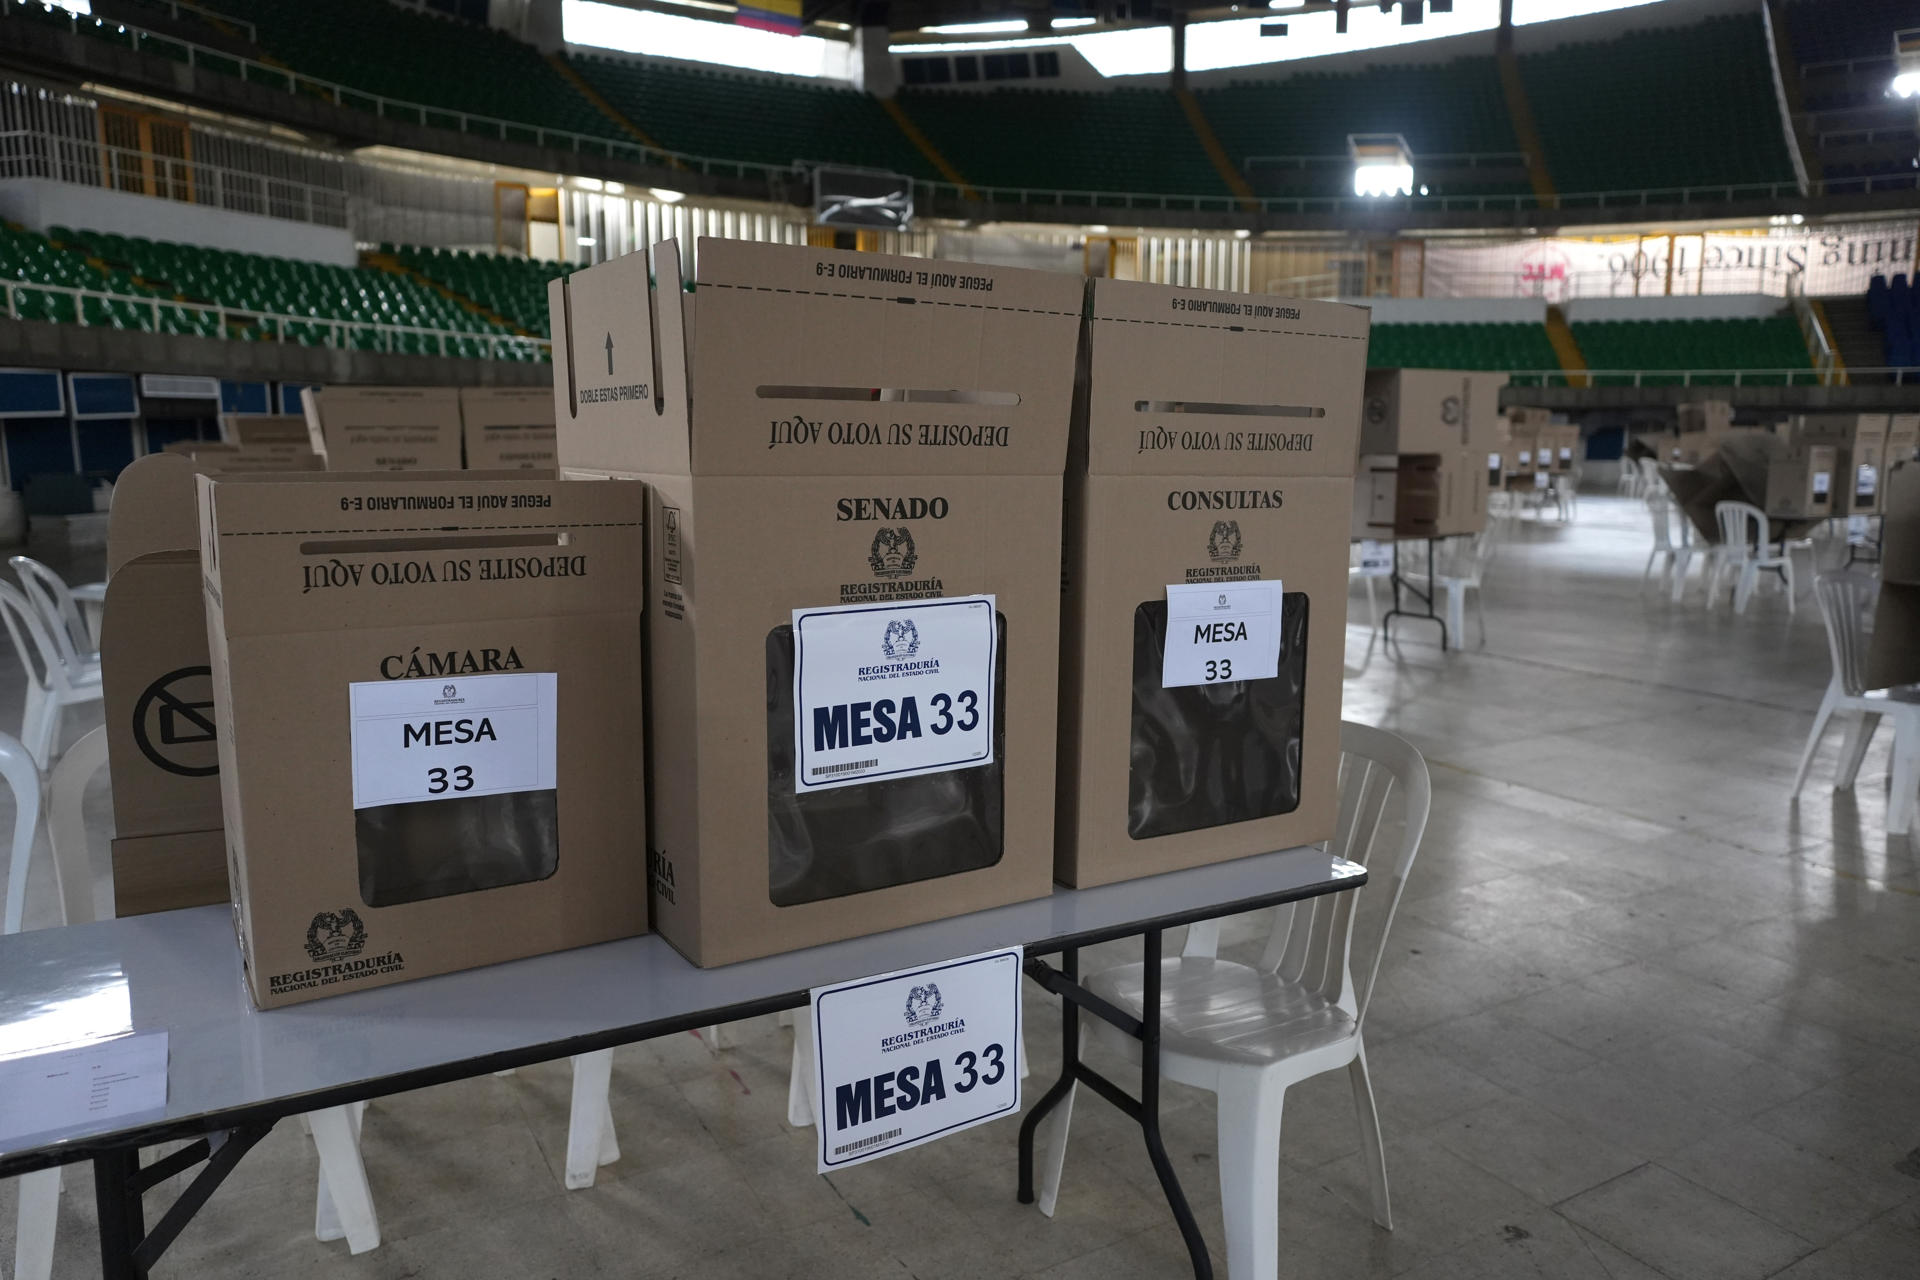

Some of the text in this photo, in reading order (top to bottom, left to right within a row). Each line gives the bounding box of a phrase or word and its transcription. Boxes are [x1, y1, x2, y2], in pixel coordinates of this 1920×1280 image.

[1703, 246, 1807, 276] Since
[816, 262, 993, 291] PEGUE AQUÍ EL FORMULARIO E-9
[1172, 298, 1300, 320] PEGUE AQUÍ EL FORMULARIO E-9
[580, 384, 649, 403] DOBLE ESTAS PRIMERO
[768, 415, 1010, 450] DEPOSITE SU VOTO AQUÍ
[1138, 426, 1314, 454] DEPOSITE SU VOTO AQUÍ
[340, 494, 551, 511] PEGUE AQUÍ EL FORMULARIO E-9
[836, 496, 949, 521] SENADO
[1167, 489, 1283, 511] CONSULTAS
[302, 555, 587, 594] DEPOSITE SU VOTO AQUÍ
[1185, 562, 1261, 578] REGISTRADURÍA
[840, 576, 943, 595] REGISTRADURÍA
[840, 594, 878, 604] NACIONAL
[879, 593, 894, 601] DEL
[895, 592, 924, 600] ESTADO
[1194, 621, 1248, 645] MESA
[380, 646, 525, 680] CÁMARA
[858, 657, 940, 676] REGISTRADURÍA
[1205, 658, 1232, 681] 33
[858, 674, 887, 682] NACIONAL
[403, 717, 497, 748] MESA
[813, 689, 980, 752] MESA 33
[427, 765, 475, 794] 33
[269, 951, 404, 987] REGISTRADURÍA
[270, 963, 405, 995] NACIONAL DEL ESTADO CIVIL
[881, 1017, 965, 1047] REGISTRADURÍA
[881, 1027, 966, 1054] NACIONAL DEL ESTADO CIVIL
[835, 1043, 1005, 1131] MESA 33
